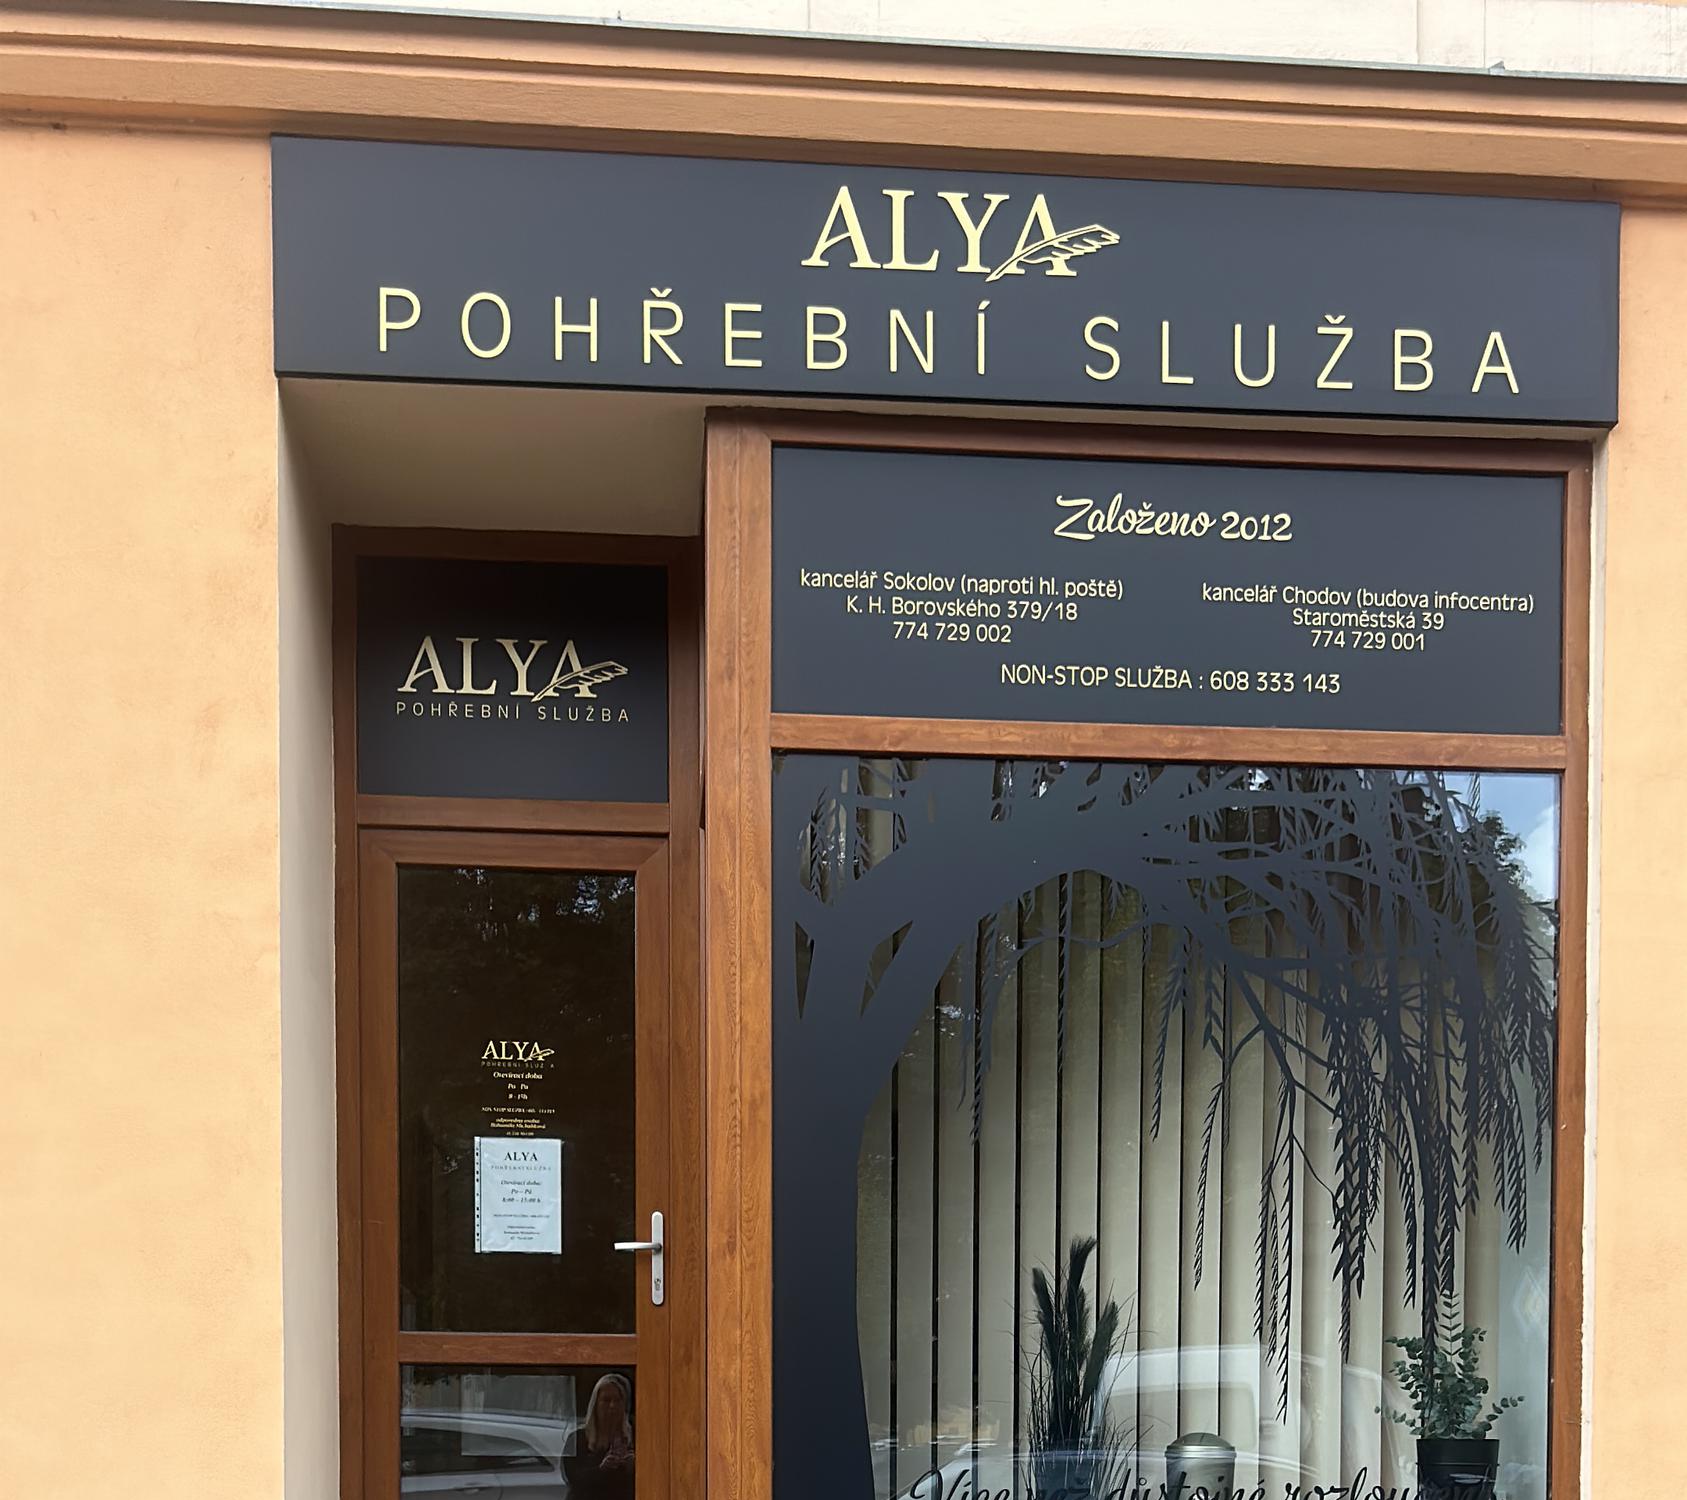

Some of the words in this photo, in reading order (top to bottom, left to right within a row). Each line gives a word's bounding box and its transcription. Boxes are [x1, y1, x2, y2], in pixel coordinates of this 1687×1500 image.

[800, 184, 1121, 283] ALYA
[378, 285, 993, 376] POHŘEBNÍ
[1083, 313, 1520, 395] SLUŽBA
[1053, 492, 1216, 541] Založeno
[1219, 510, 1293, 542] 2012
[799, 567, 879, 590] kancelář
[882, 570, 956, 593] Sokolov
[959, 572, 1034, 597] (naproti
[1038, 575, 1060, 597] hl.
[1063, 577, 1124, 601] poště)
[1201, 581, 1279, 604] kancelář
[1281, 584, 1353, 608] Chodov
[1355, 586, 1430, 609] (budova
[1432, 588, 1535, 615] infocentra)
[846, 594, 864, 614] K.
[868, 594, 887, 615] H.
[890, 596, 1002, 619] Borovského
[1006, 599, 1079, 622] 379/18
[1291, 607, 1417, 630] Staroměstská
[1420, 611, 1446, 632] 39
[892, 620, 930, 641] 774
[933, 622, 972, 643] 729
[974, 623, 1013, 644] 002
[1309, 629, 1347, 649] 774
[1350, 630, 1387, 651] 729
[1390, 631, 1426, 652] 001
[396, 635, 629, 703] ALYA
[1000, 663, 1110, 688] NON-STOP
[1113, 664, 1194, 690] SLUŽBA
[1208, 669, 1251, 692] 608
[1255, 670, 1296, 693] 333
[1301, 673, 1342, 695] 143
[395, 701, 520, 721] POHŘEBNÍ
[536, 704, 630, 723] SLUŽBA
[481, 1040, 555, 1062] ALYA
[504, 1151, 538, 1161] ALYA
